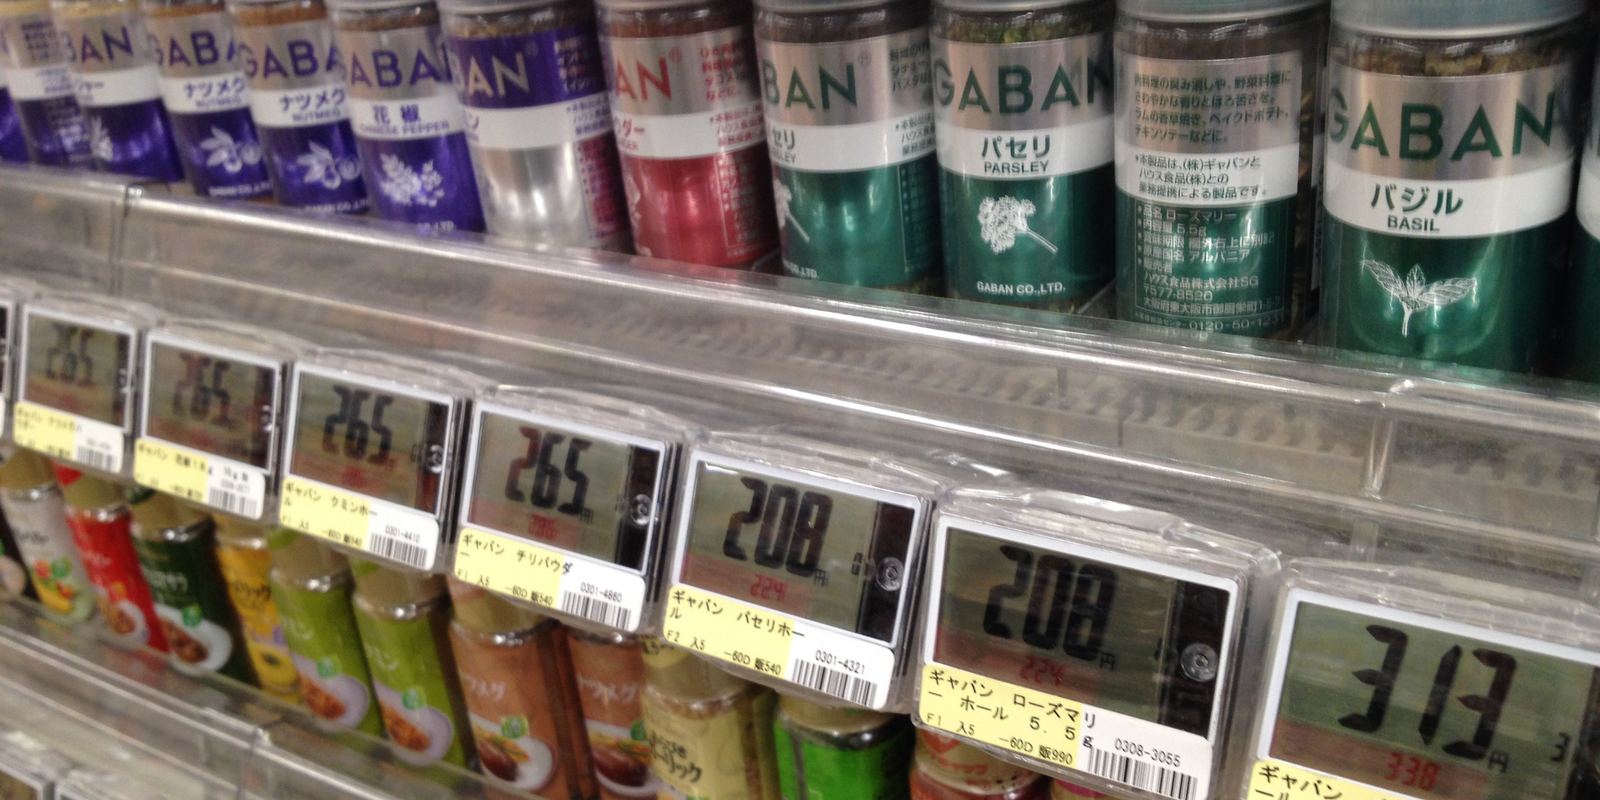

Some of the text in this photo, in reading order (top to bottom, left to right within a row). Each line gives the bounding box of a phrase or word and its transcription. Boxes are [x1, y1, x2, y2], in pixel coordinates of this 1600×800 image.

[1329, 86, 1556, 161] GABAN
[981, 135, 1051, 159] パセリ
[984, 160, 1049, 174] PARSLEY
[1371, 183, 1464, 216] バジル
[1387, 214, 1440, 231] BASIL
[976, 281, 1014, 295] GABAN
[322, 384, 394, 465] 265
[505, 425, 592, 515] 265
[723, 476, 833, 578] 208
[463, 533, 573, 575] ギャバン チリパウダ
[673, 590, 805, 638] ギャバン パセリホー
[983, 544, 1117, 662] 208
[815, 649, 865, 675] 0301-4321
[930, 669, 1095, 728] ギャバン ローズマリ
[960, 694, 1008, 721] ホール
[1338, 624, 1517, 760] 313
[1114, 737, 1181, 768] 0308-3055
[1381, 750, 1441, 791] 338
[1259, 765, 1343, 800] ギャバン
